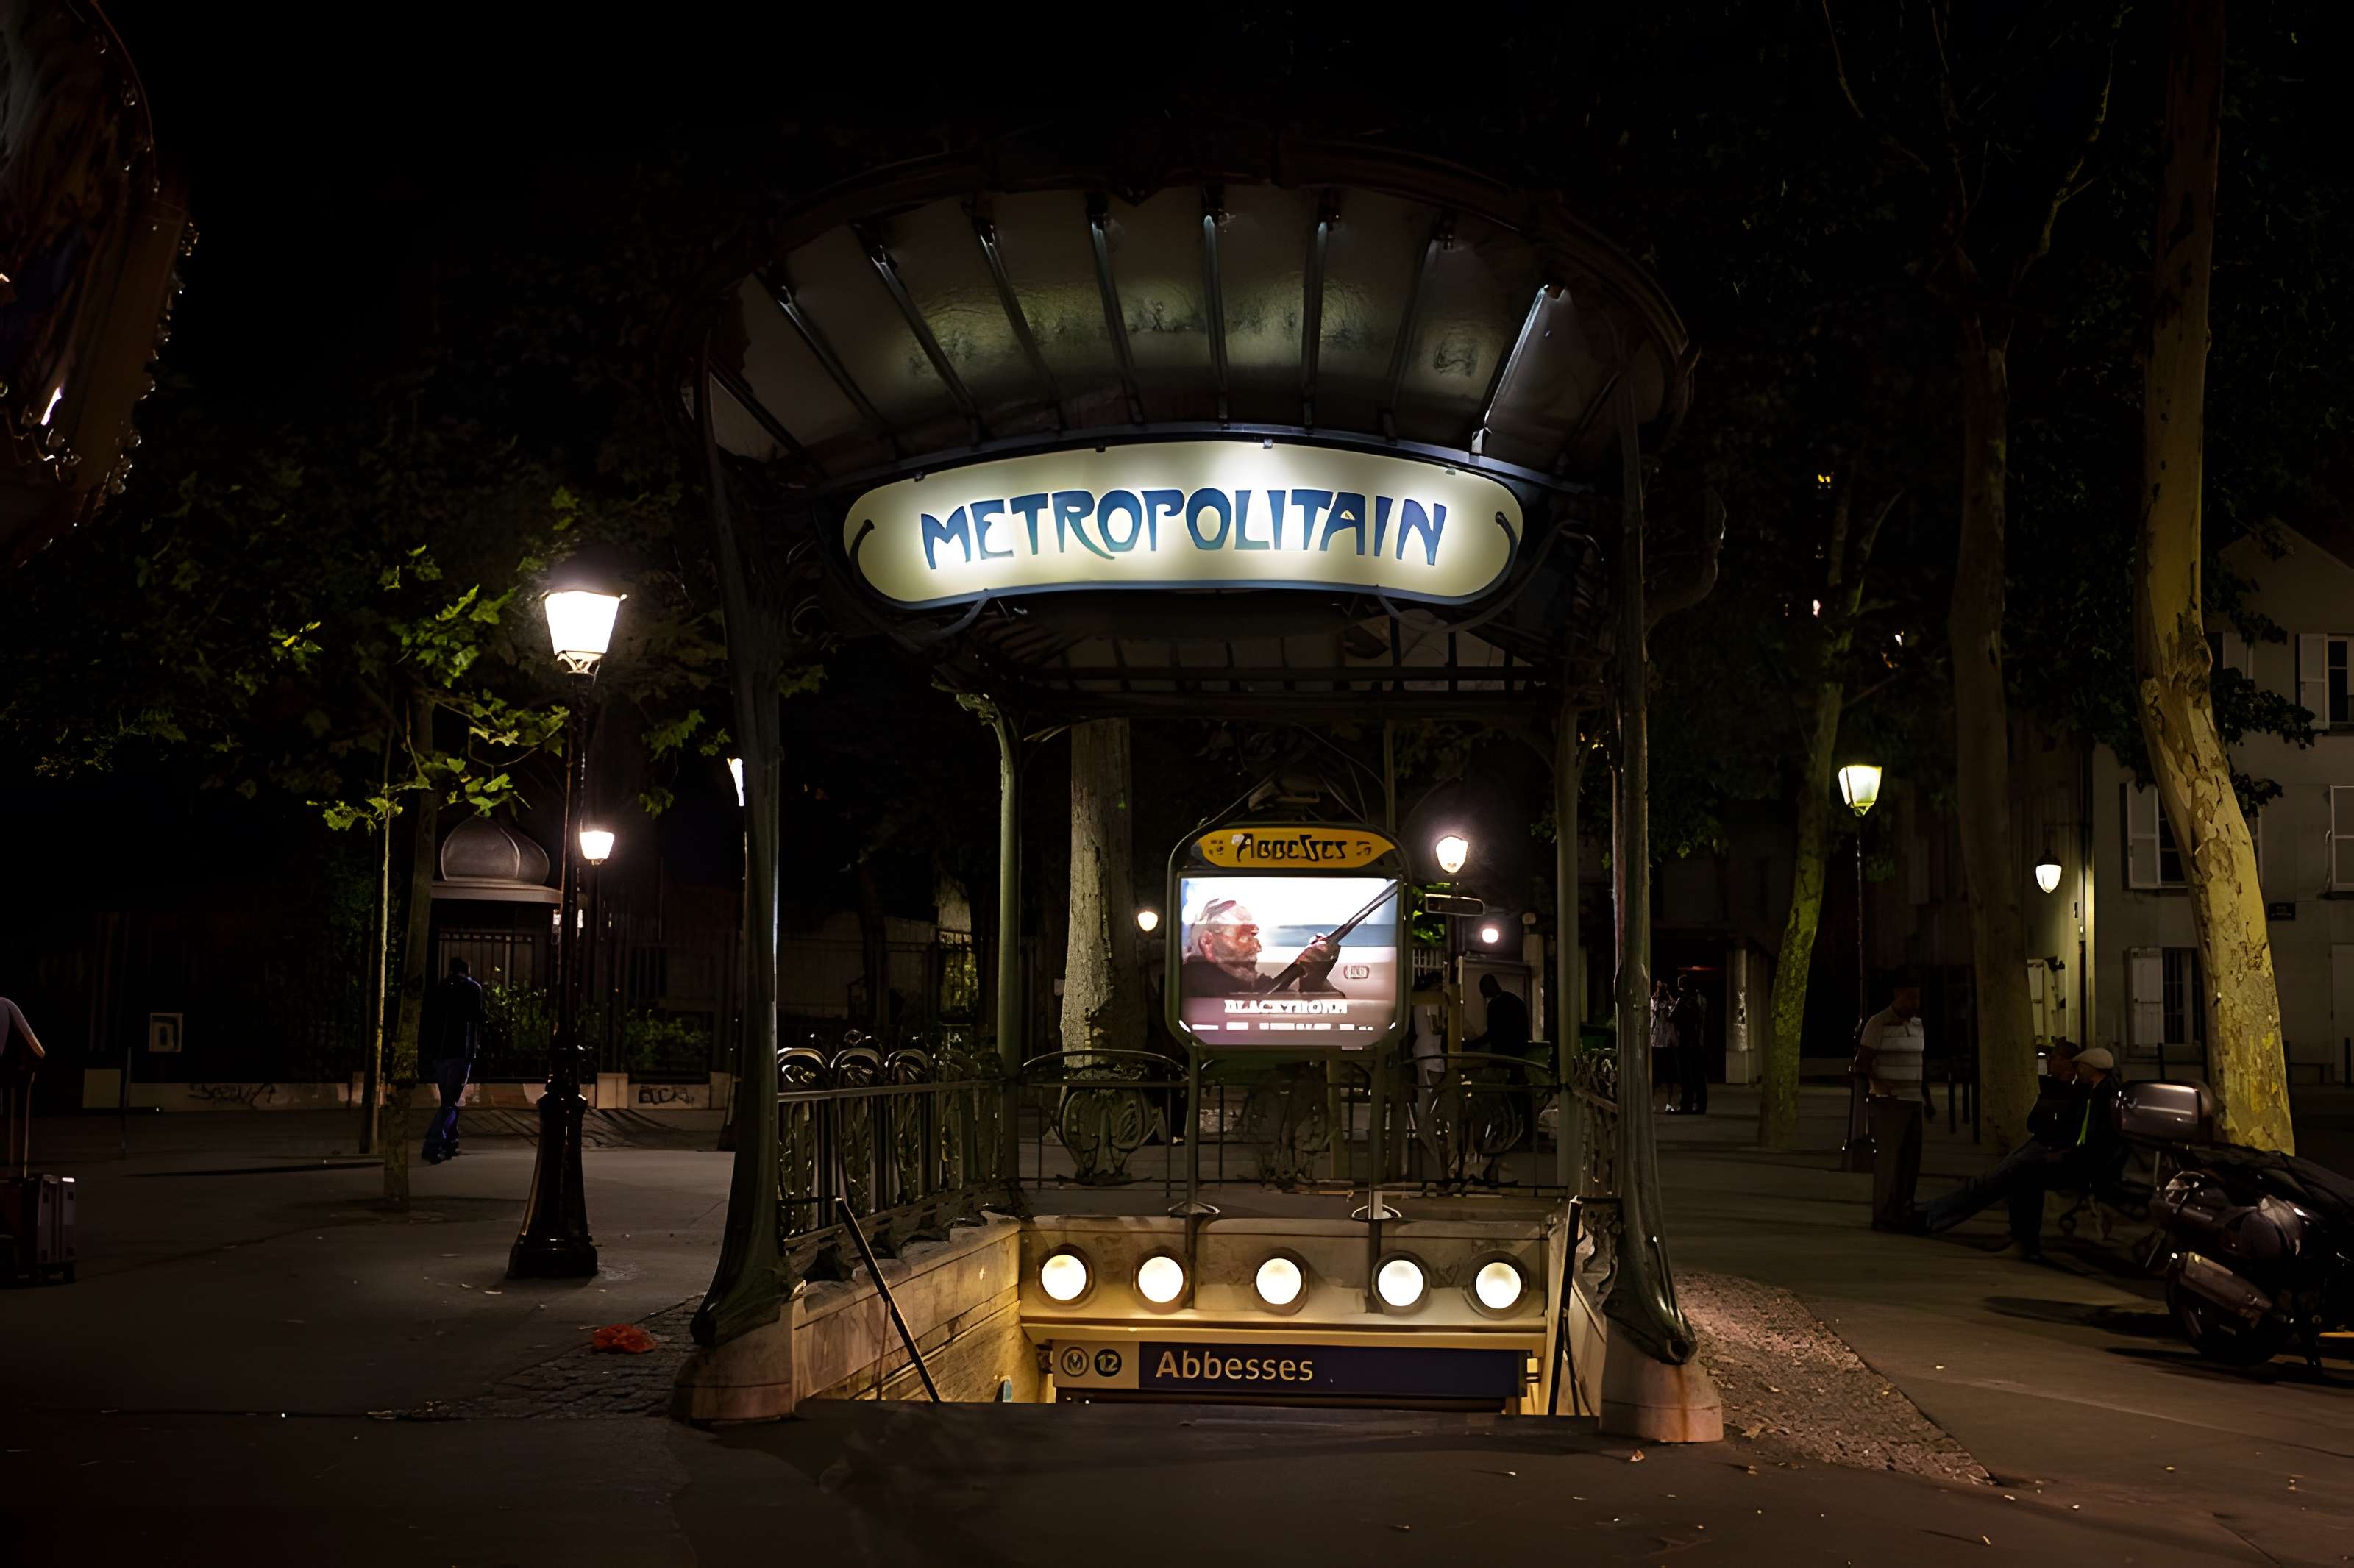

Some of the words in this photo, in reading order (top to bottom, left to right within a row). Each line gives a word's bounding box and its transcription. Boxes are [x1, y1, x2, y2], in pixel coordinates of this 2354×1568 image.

[920, 487, 1447, 570] METROPOLITAIN
[1097, 1354, 1119, 1372] 12
[1155, 1349, 1314, 1382] Abbesses
